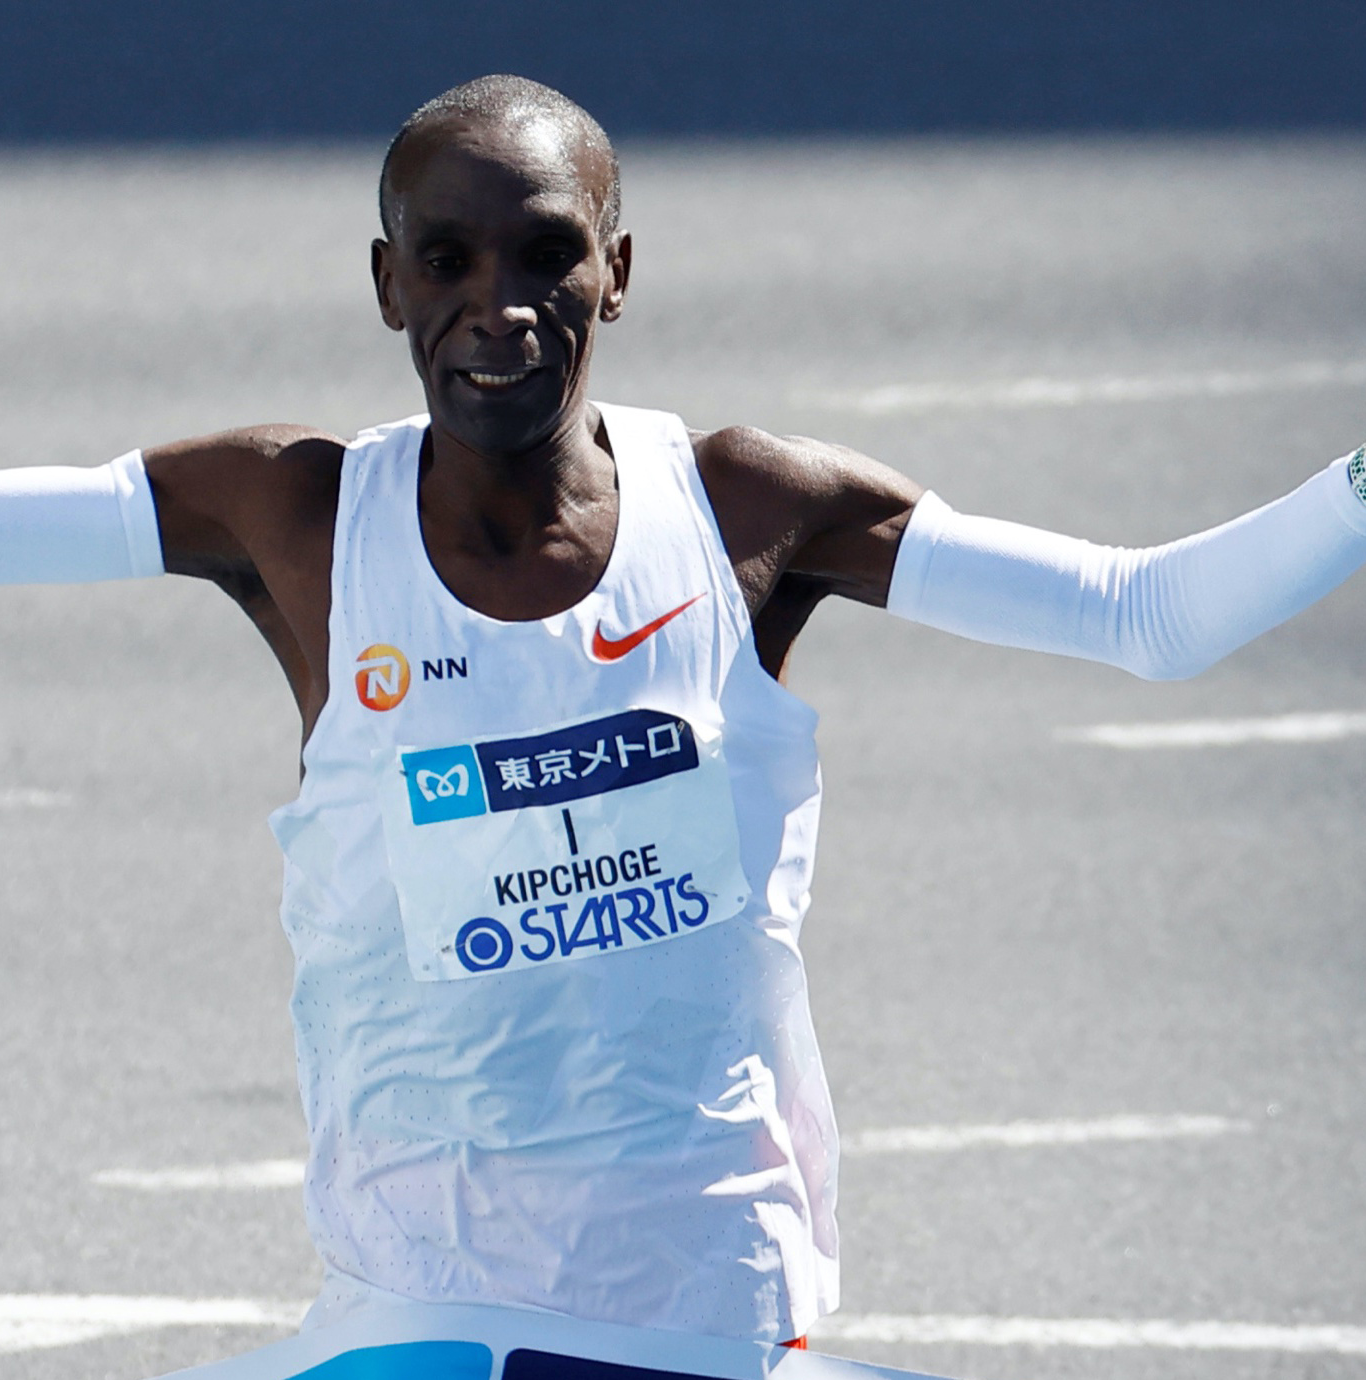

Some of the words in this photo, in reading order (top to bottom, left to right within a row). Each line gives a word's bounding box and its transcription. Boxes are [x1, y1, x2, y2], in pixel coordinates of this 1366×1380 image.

[421, 656, 468, 682] NN
[494, 720, 684, 791] 東京メトロ
[493, 843, 662, 907] KIPCHOGE
